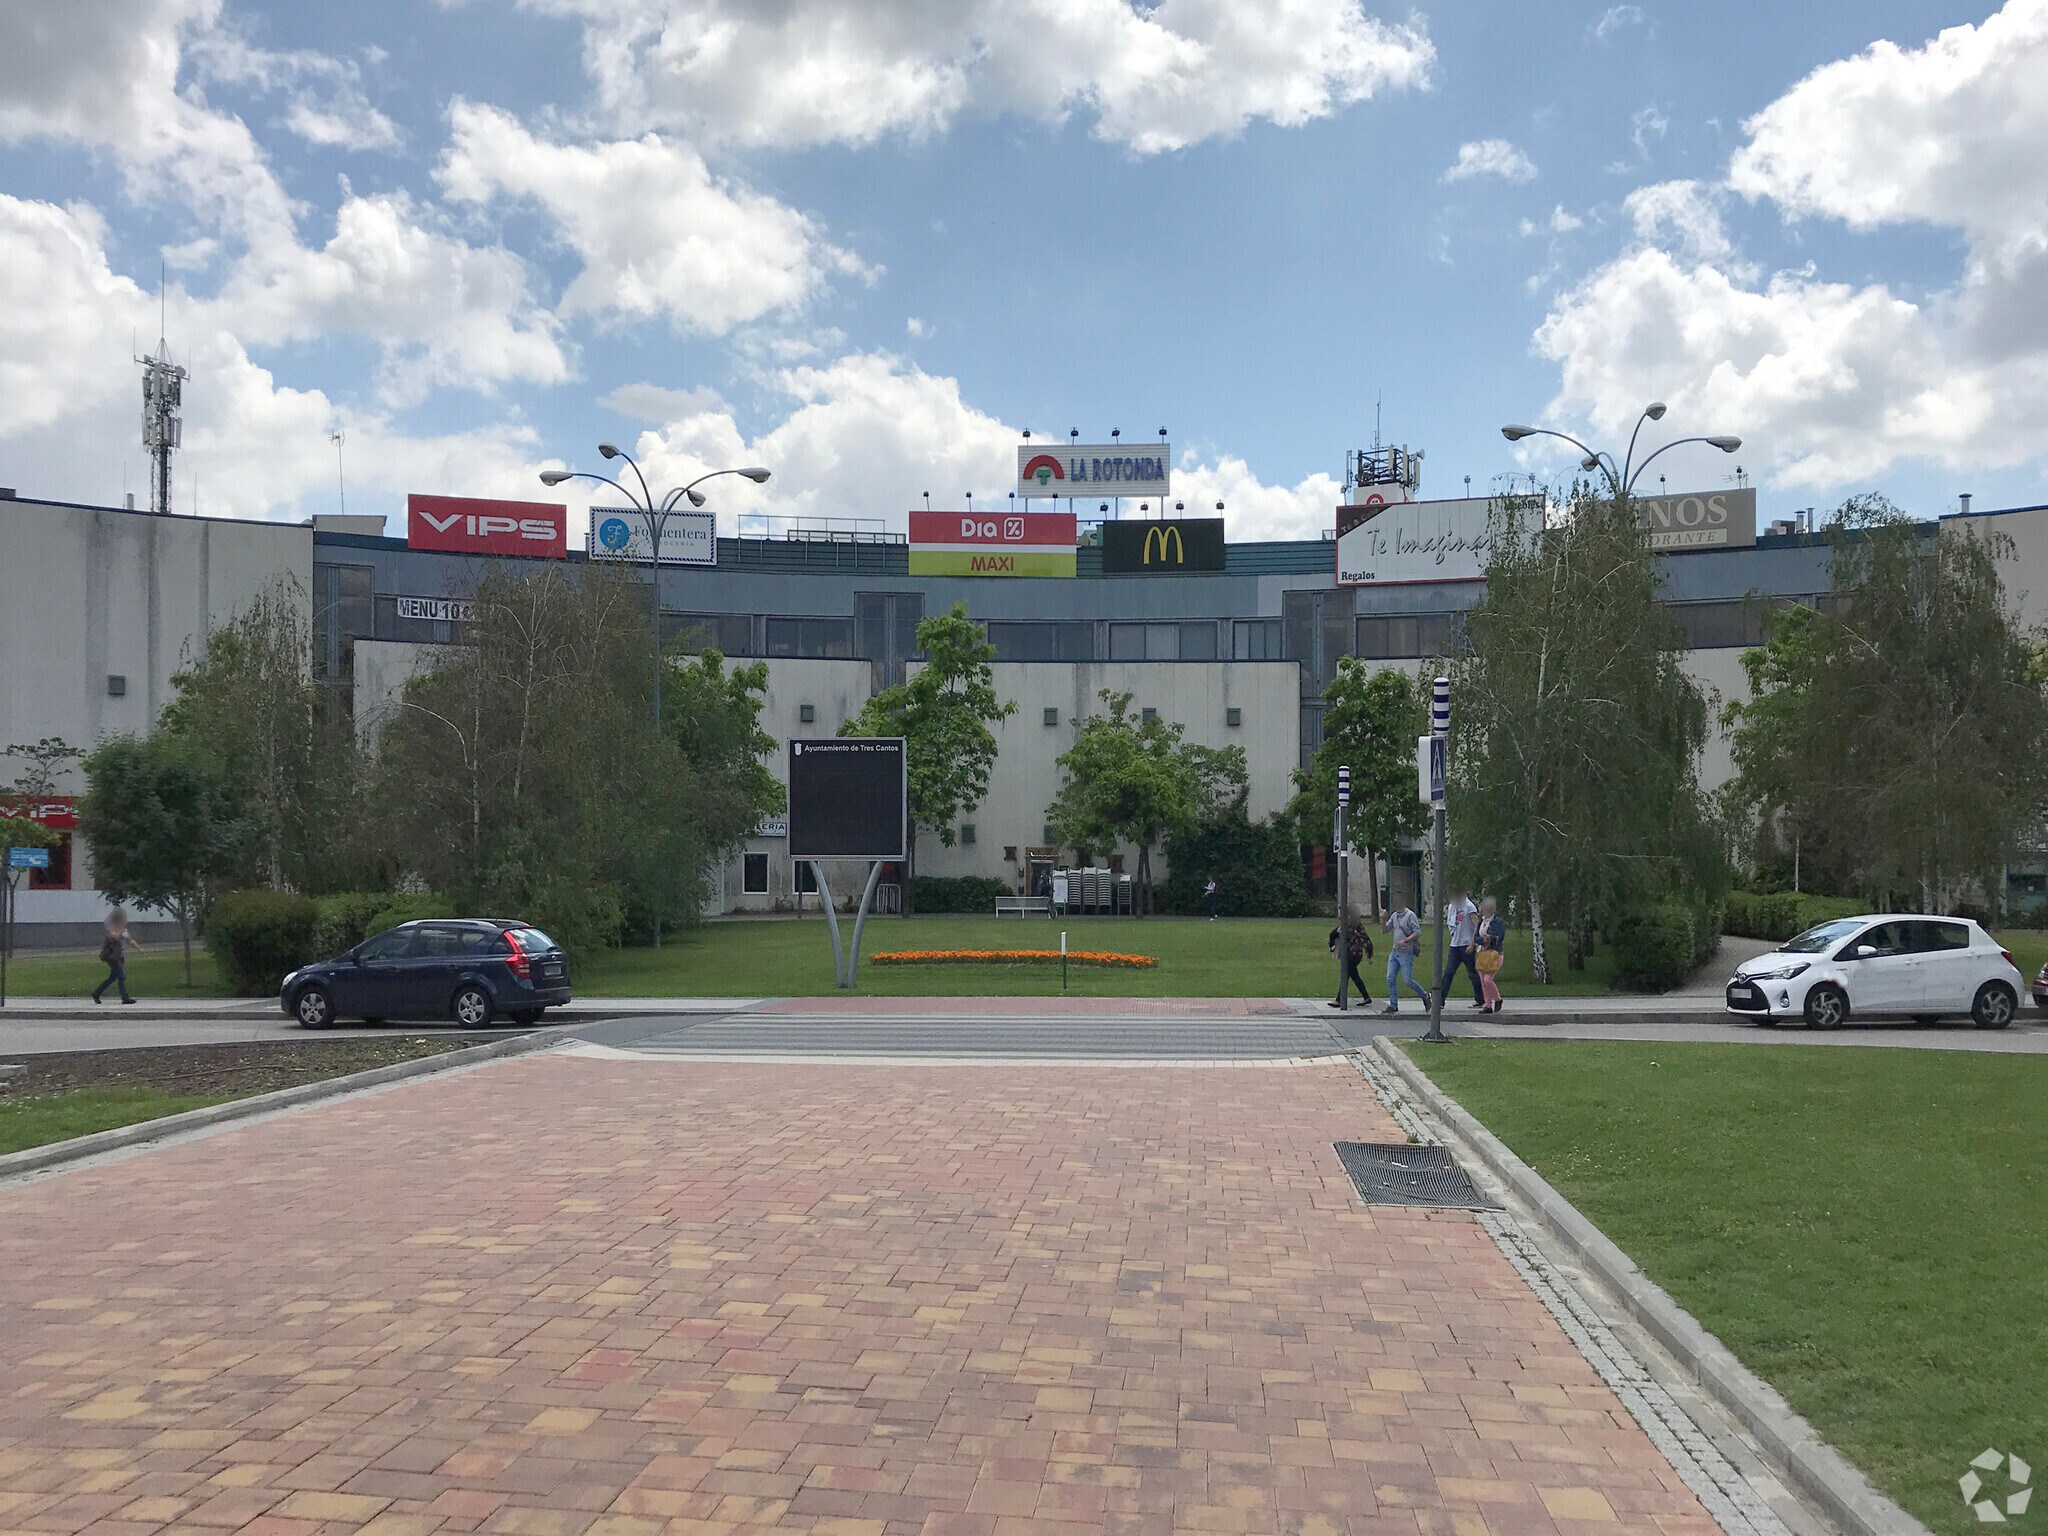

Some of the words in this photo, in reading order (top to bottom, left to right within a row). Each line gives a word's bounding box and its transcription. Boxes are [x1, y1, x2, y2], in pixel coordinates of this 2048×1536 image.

[1071, 458, 1087, 481] LA
[1092, 457, 1165, 481] ROTONDA
[418, 511, 557, 541] VIPS
[1367, 528, 1387, 556] Te
[971, 556, 1014, 571] MAXI
[1341, 571, 1375, 581] Regalos
[400, 599, 438, 618] MENU
[442, 602, 460, 619] 10
[804, 744, 849, 753] Ayuntamiento
